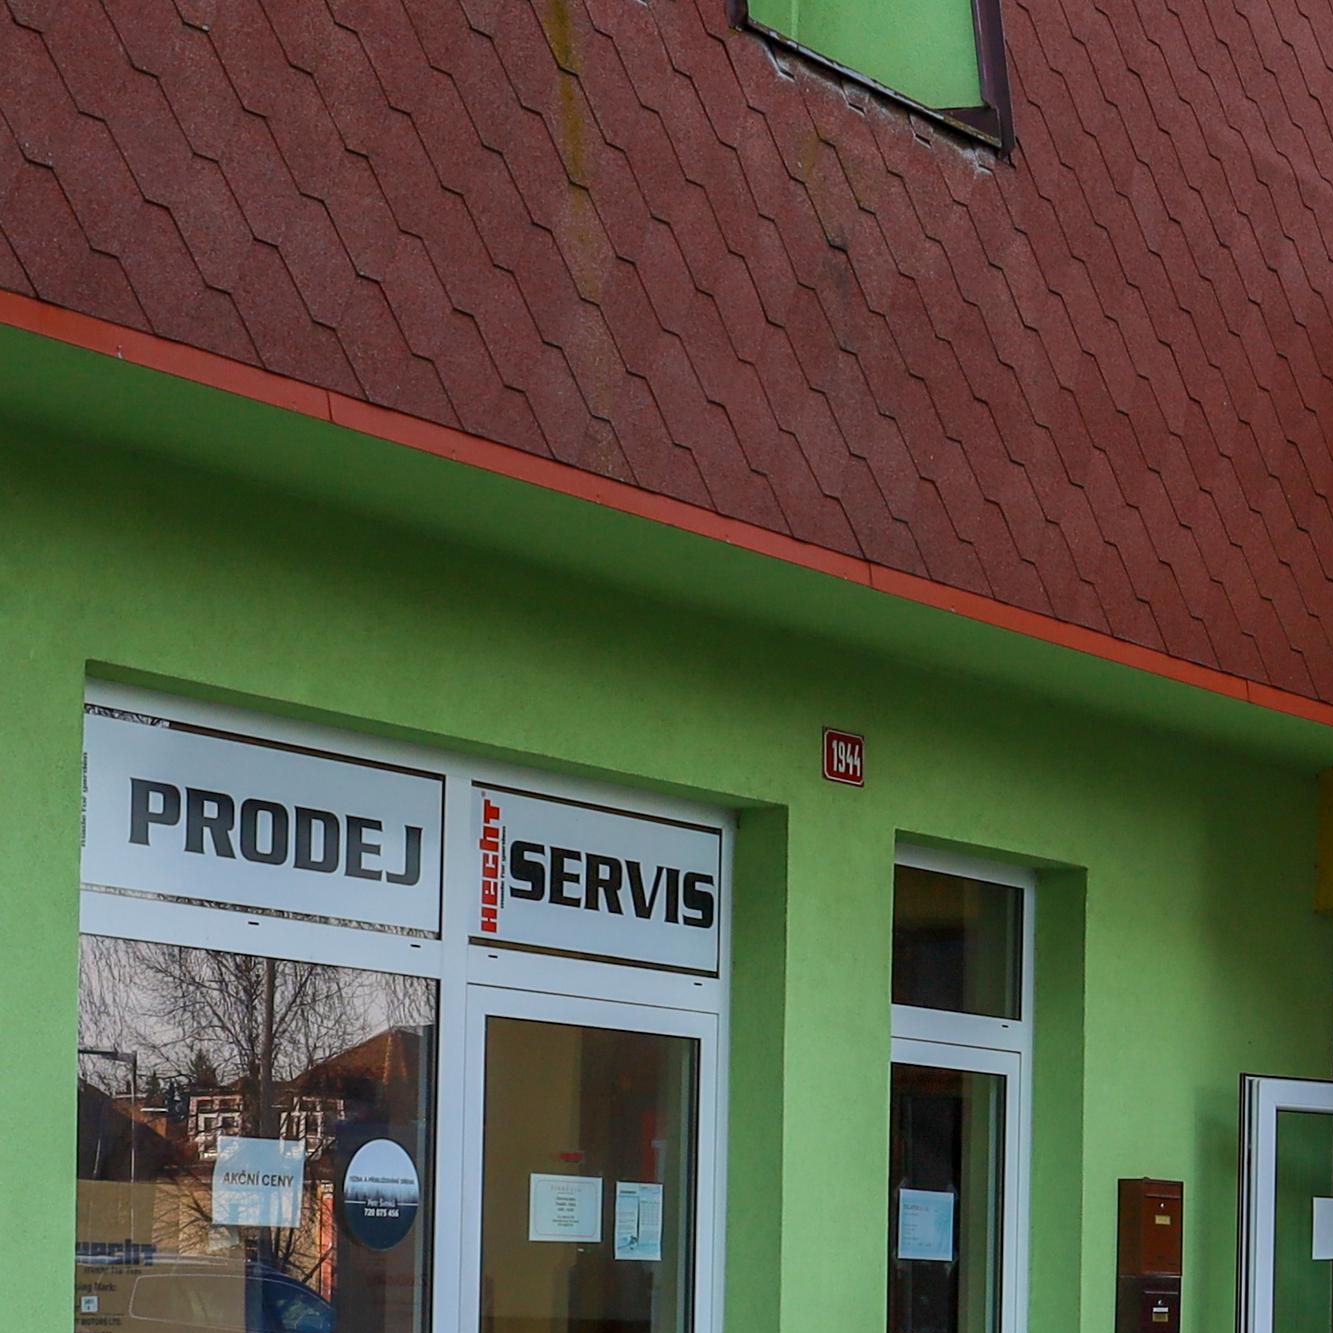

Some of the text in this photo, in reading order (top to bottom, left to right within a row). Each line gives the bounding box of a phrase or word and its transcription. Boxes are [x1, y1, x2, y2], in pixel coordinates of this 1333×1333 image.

[832, 740, 861, 777] 1944
[129, 777, 423, 887] PRODEJ
[510, 840, 715, 929] SERVIS
[223, 1170, 294, 1188] AKČNÍ CENY
